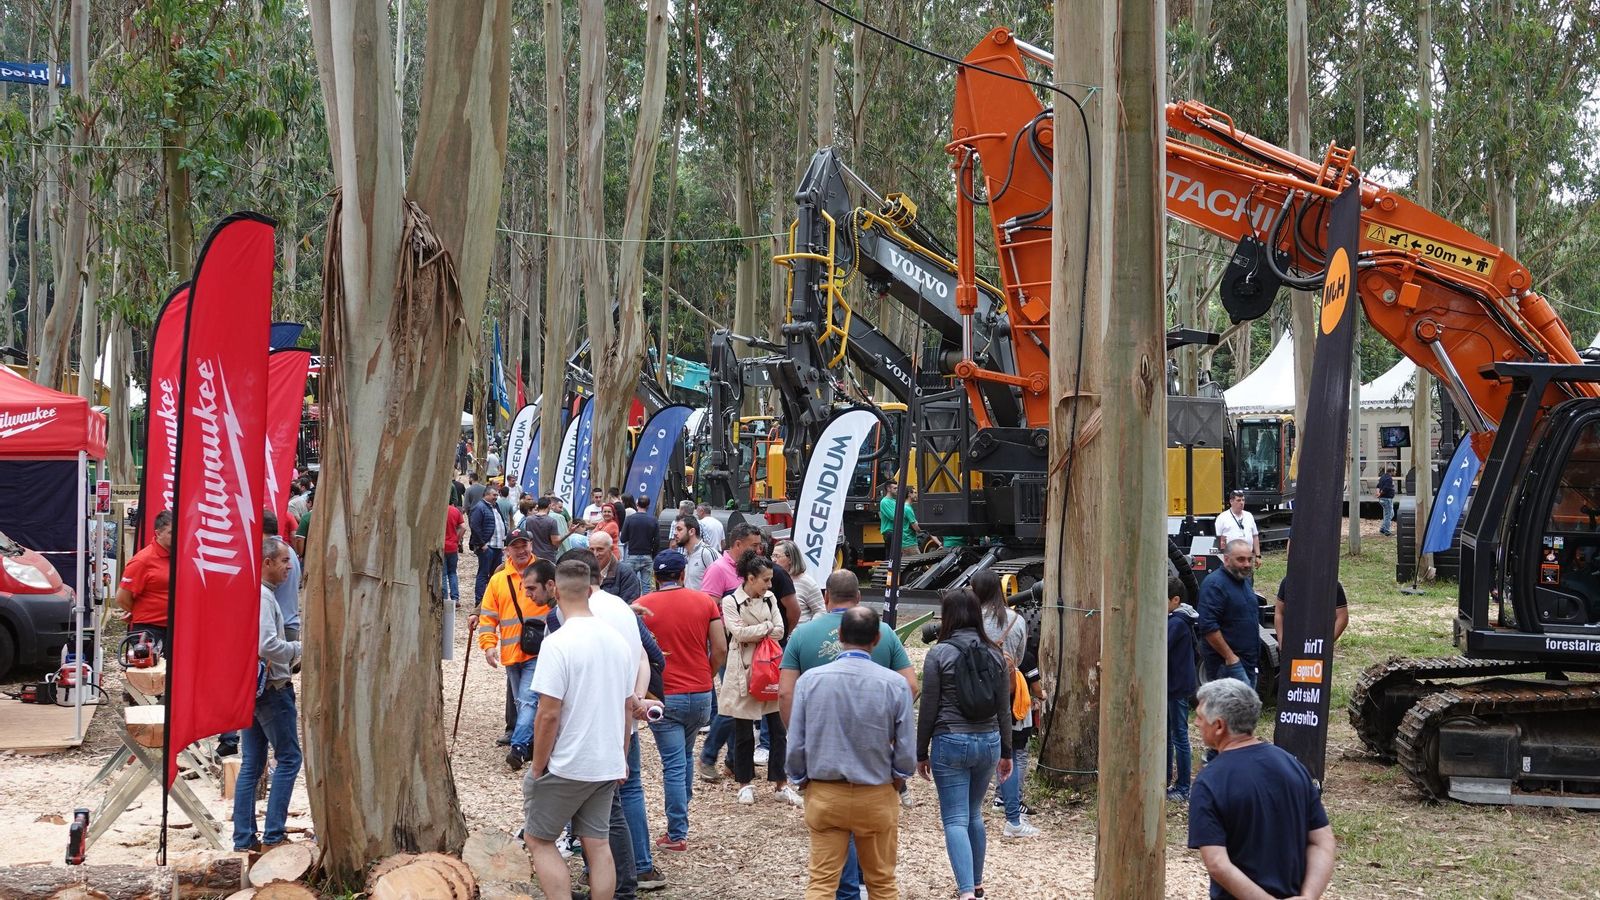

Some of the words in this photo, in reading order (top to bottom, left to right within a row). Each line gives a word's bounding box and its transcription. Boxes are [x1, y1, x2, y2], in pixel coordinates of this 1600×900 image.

[1167, 170, 1276, 232] TACHI
[888, 247, 948, 298] VOLVO
[1425, 243, 1457, 263] 90m
[0, 406, 57, 429] ilwaukee
[511, 419, 527, 479] SCENDUM
[191, 357, 242, 588] Milwaukee
[560, 429, 578, 504] ASCENDU
[639, 428, 666, 493] OLVO
[1441, 456, 1470, 525] VOLV
[805, 435, 852, 567] ASCENDUM
